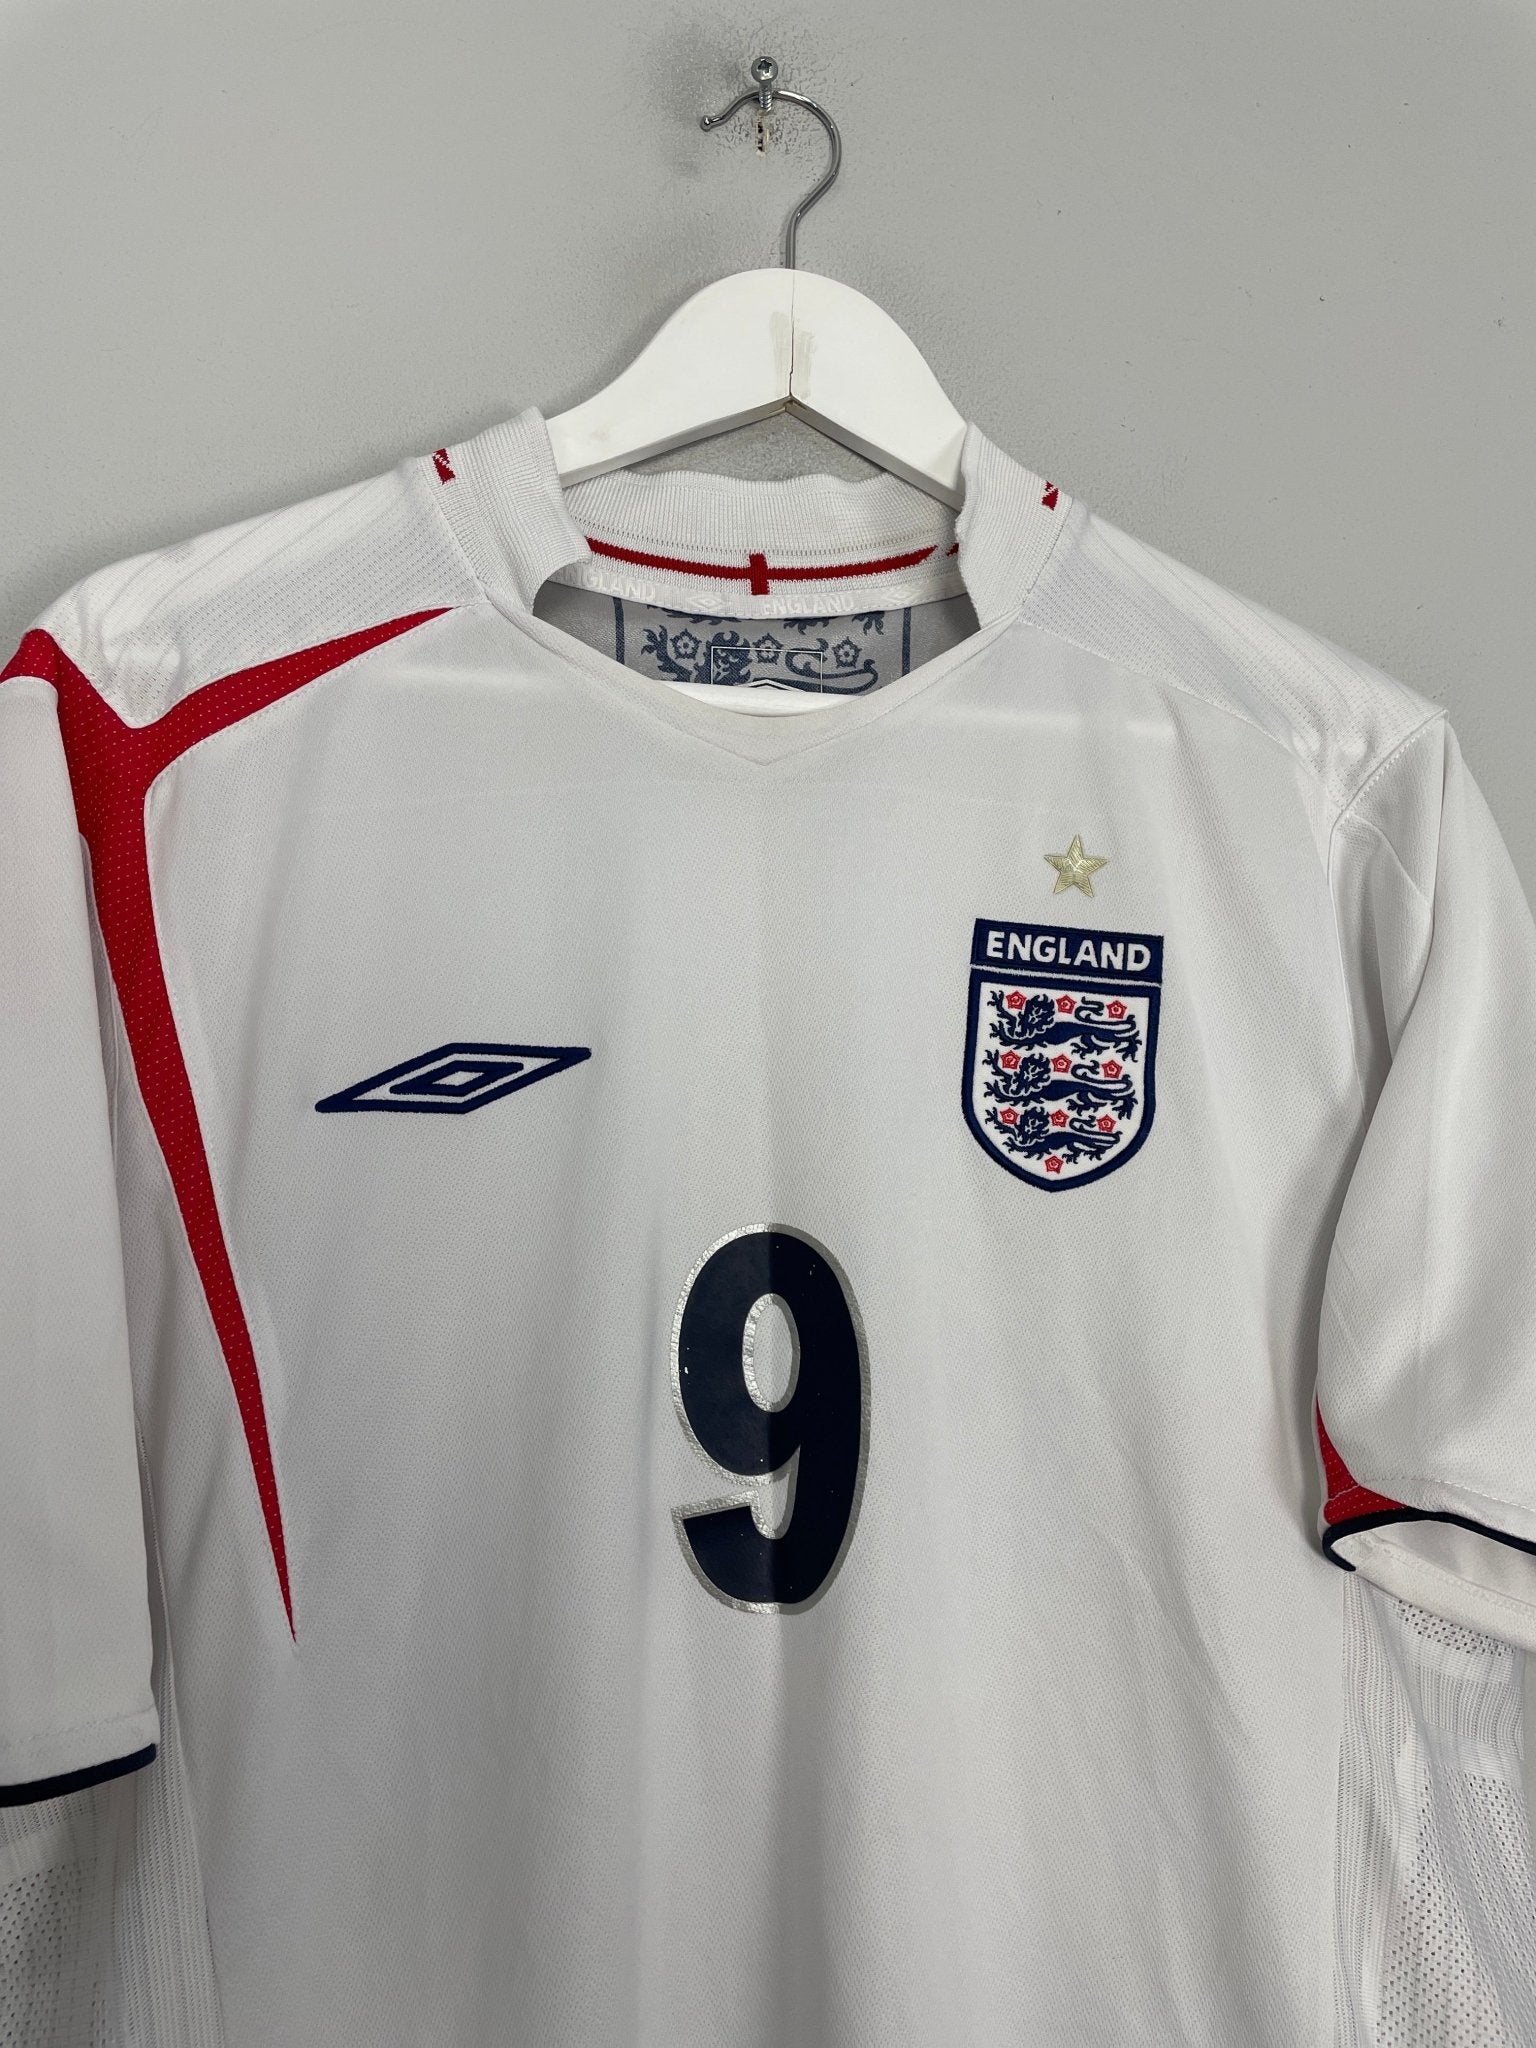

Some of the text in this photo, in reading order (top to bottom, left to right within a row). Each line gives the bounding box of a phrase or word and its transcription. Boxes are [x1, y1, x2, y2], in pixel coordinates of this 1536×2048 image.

[762, 592, 855, 615] ENGLAND
[985, 930, 1152, 973] ENGLAND
[670, 1223, 872, 1615] 9
